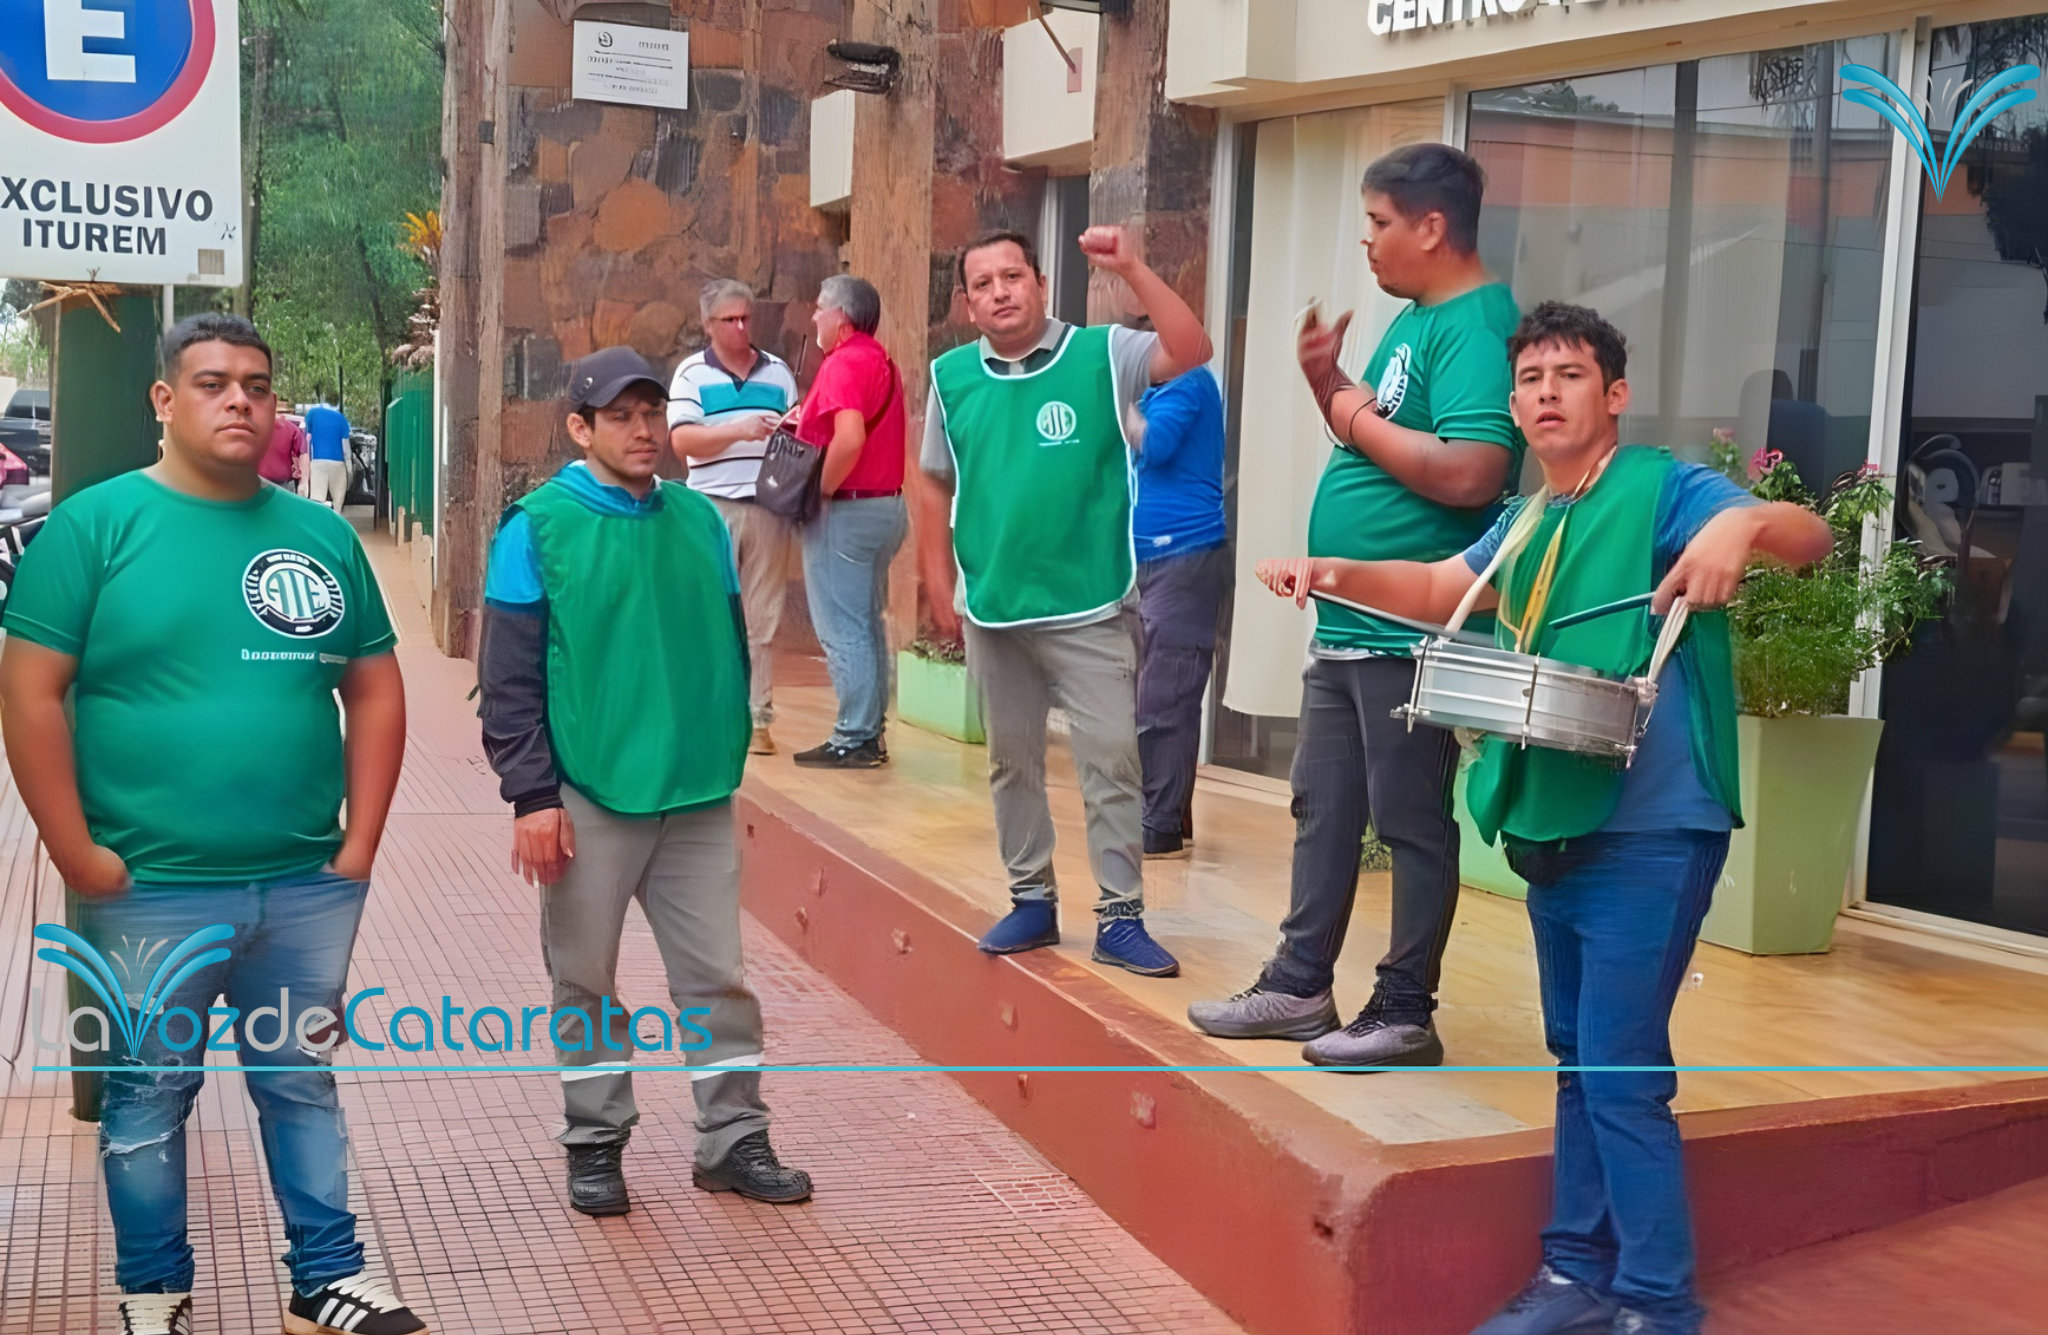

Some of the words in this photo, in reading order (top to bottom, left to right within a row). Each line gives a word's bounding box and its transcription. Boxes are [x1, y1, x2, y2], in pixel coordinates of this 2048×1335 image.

[1367, 0, 1524, 36] CEN
[0, 176, 213, 222] XCLUSIVO
[23, 218, 166, 255] ITUREM
